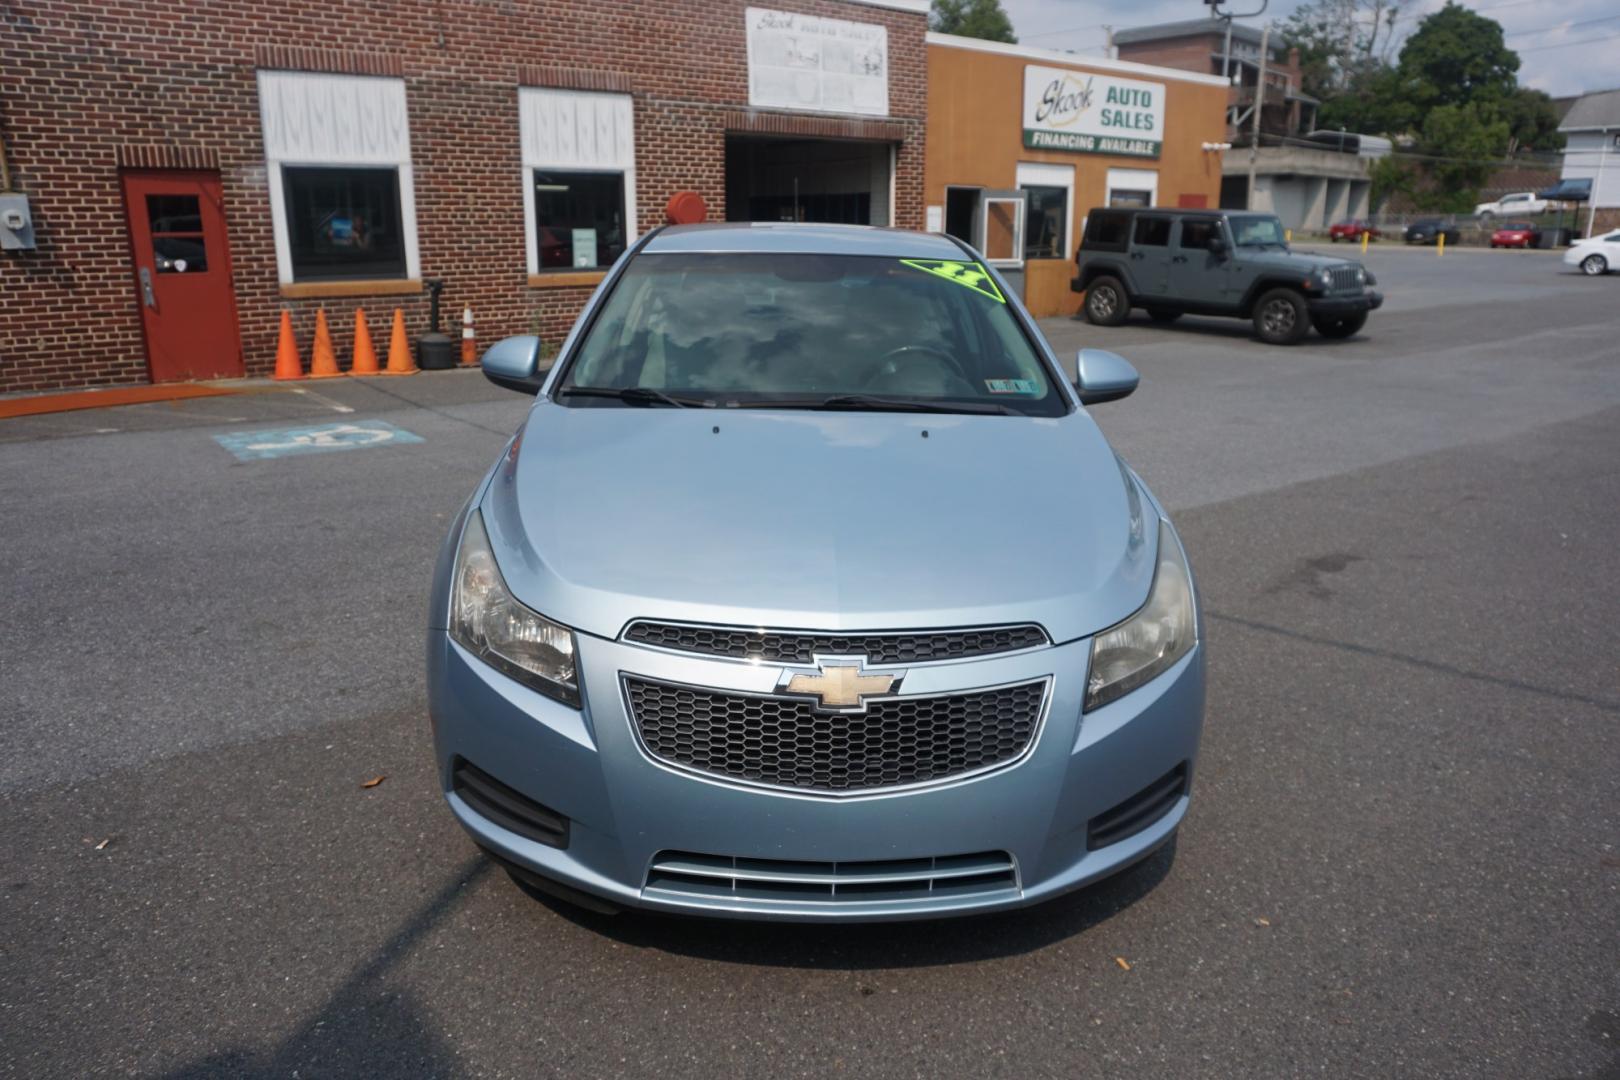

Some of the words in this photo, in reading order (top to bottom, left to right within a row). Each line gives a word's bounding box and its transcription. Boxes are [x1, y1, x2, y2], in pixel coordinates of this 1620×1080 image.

[1035, 76, 1093, 122] Skook
[1106, 85, 1152, 108] AUTO
[1100, 108, 1154, 131] SALES
[1031, 131, 1095, 151] FINANCING
[1098, 137, 1154, 155] AVAILABLE
